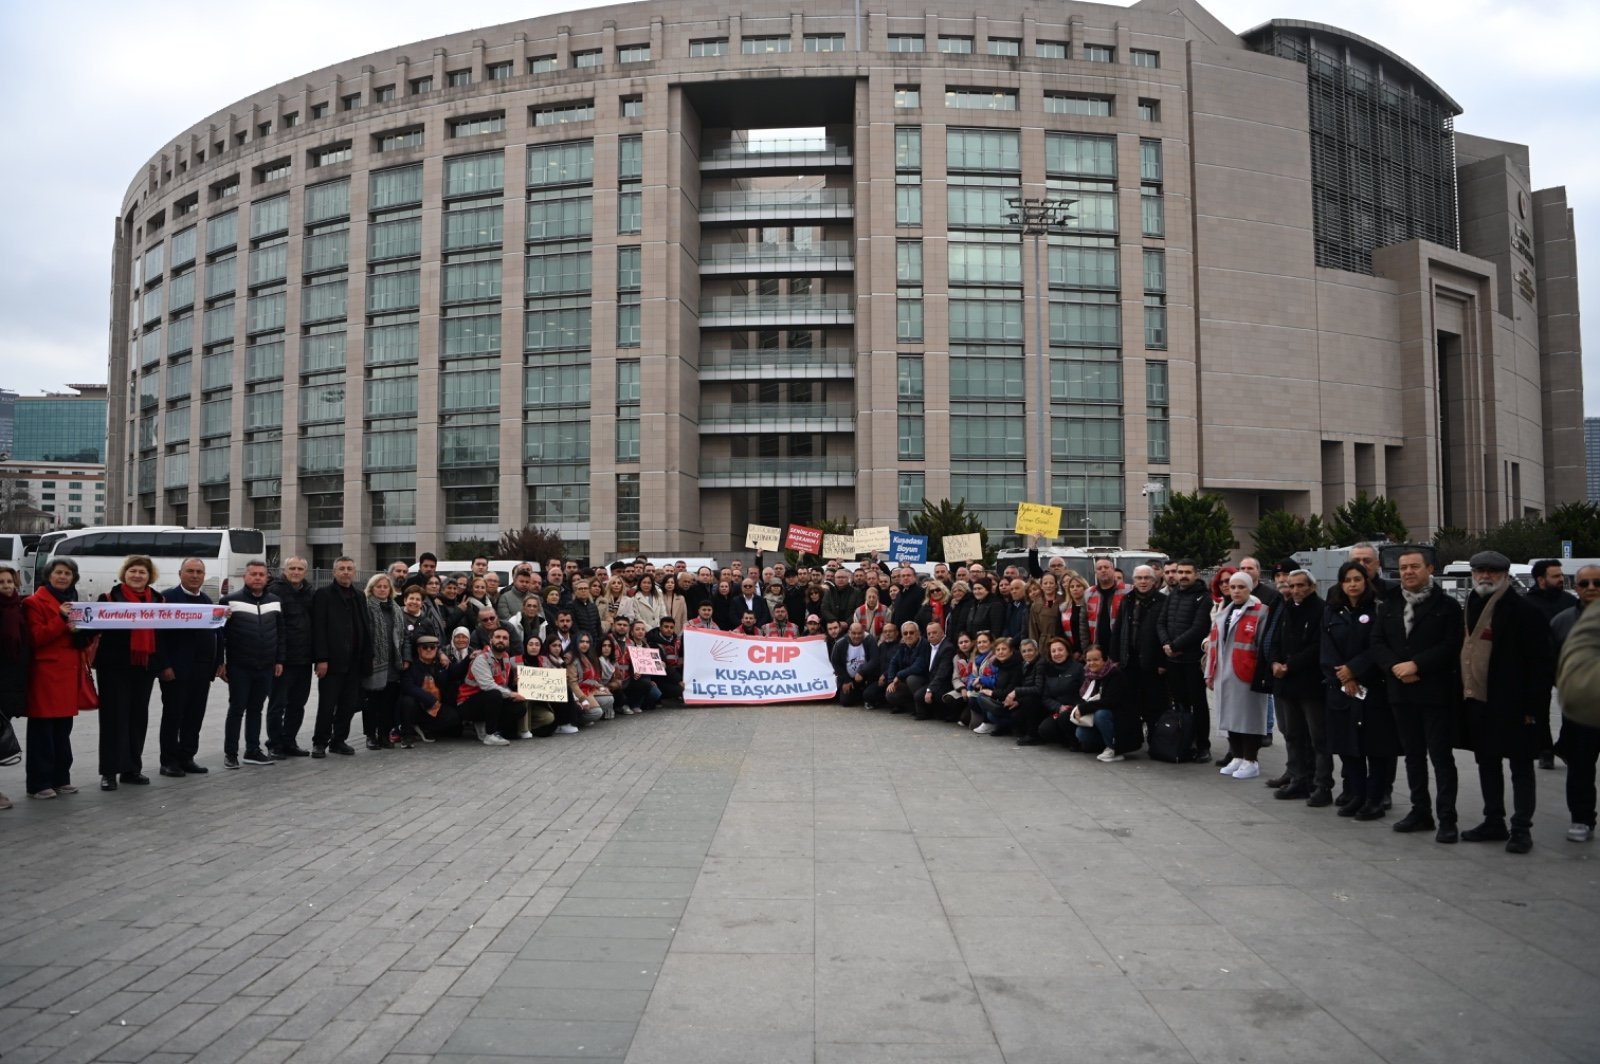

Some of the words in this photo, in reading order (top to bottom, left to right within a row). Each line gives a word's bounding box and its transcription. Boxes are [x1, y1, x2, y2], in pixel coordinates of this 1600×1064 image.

[893, 536, 923, 545] Kuşadası
[897, 545, 918, 553] Boyun
[895, 553, 920, 562] Eğmez!
[98, 610, 136, 622] Kurtuluş
[140, 610, 155, 619] Yok
[159, 610, 173, 619] Tek
[747, 645, 801, 664] CHP
[715, 668, 797, 683] KUŞADASI
[692, 679, 728, 698] İLÇE
[731, 679, 829, 698] BAŞKANLIĞI
